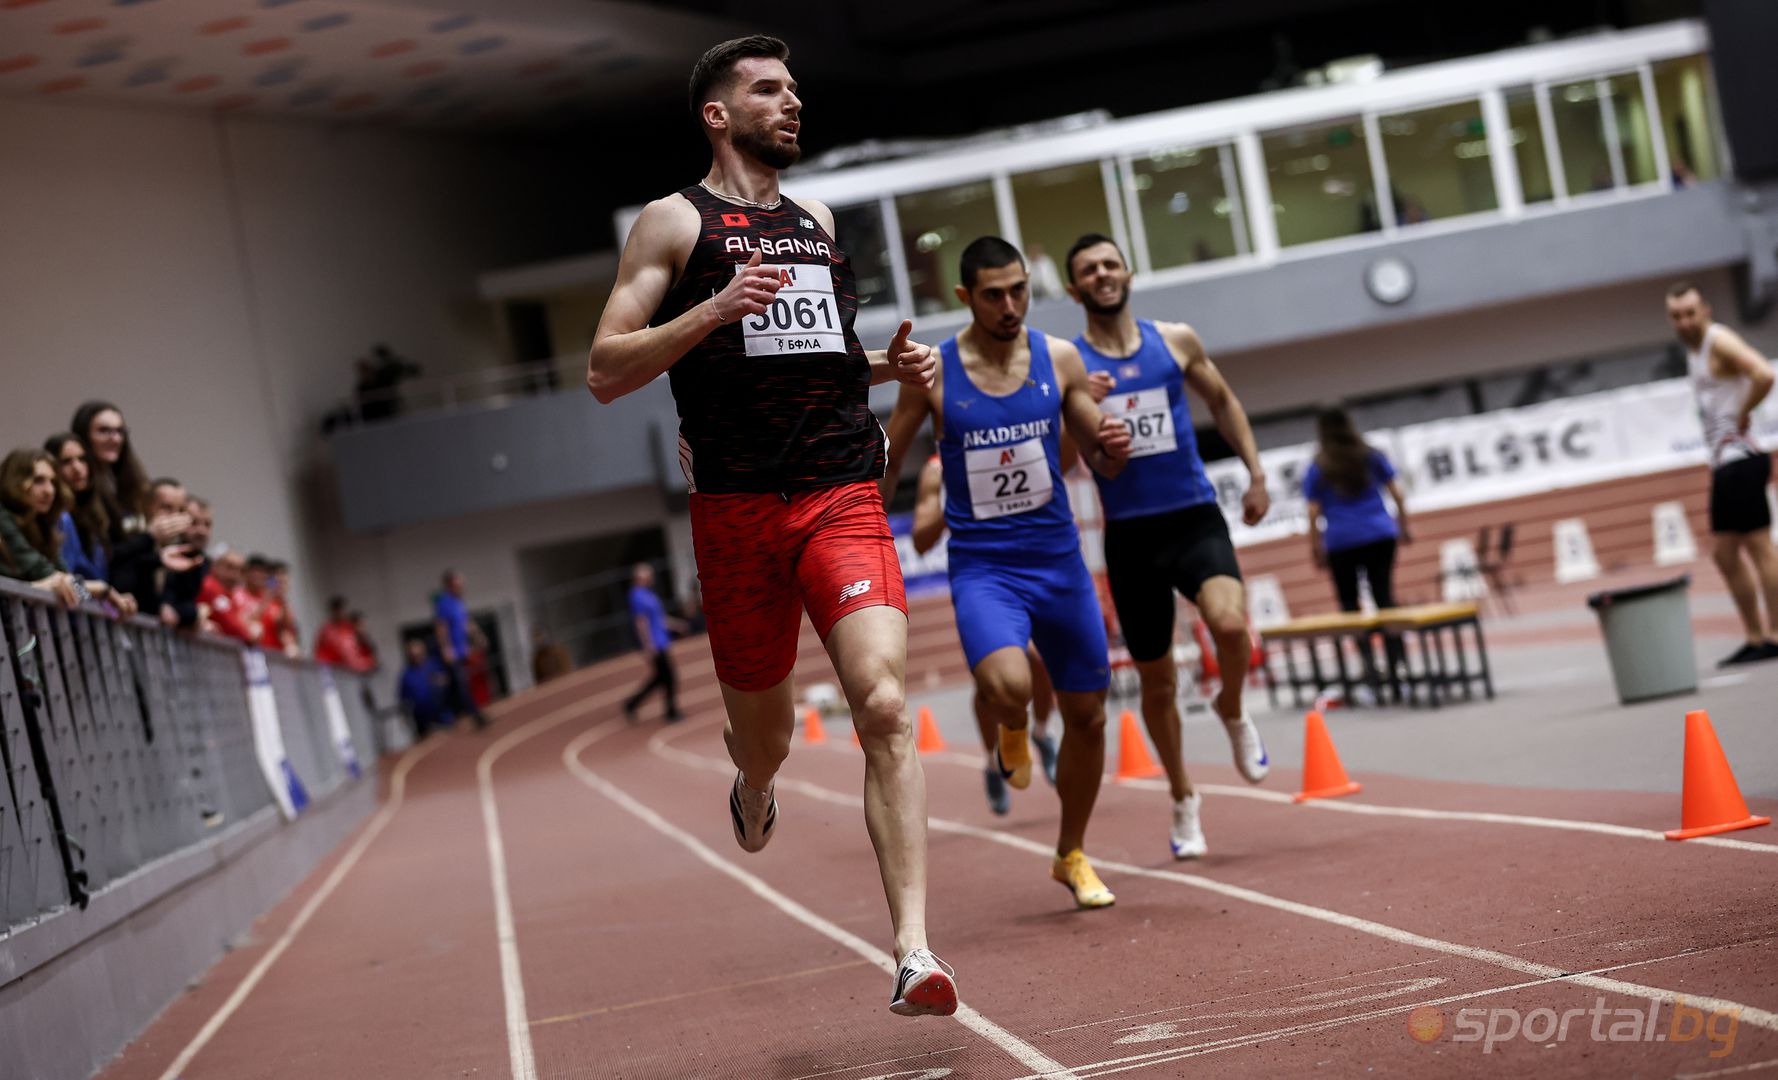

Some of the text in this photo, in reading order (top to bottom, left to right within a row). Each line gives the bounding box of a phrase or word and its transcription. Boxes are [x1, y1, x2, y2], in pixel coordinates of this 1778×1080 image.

[725, 236, 831, 258] ALBANIA
[750, 298, 832, 331] 3061
[788, 339, 821, 350] БФЛА
[964, 418, 1051, 448] AKADEMIK
[993, 470, 1030, 498] 22
